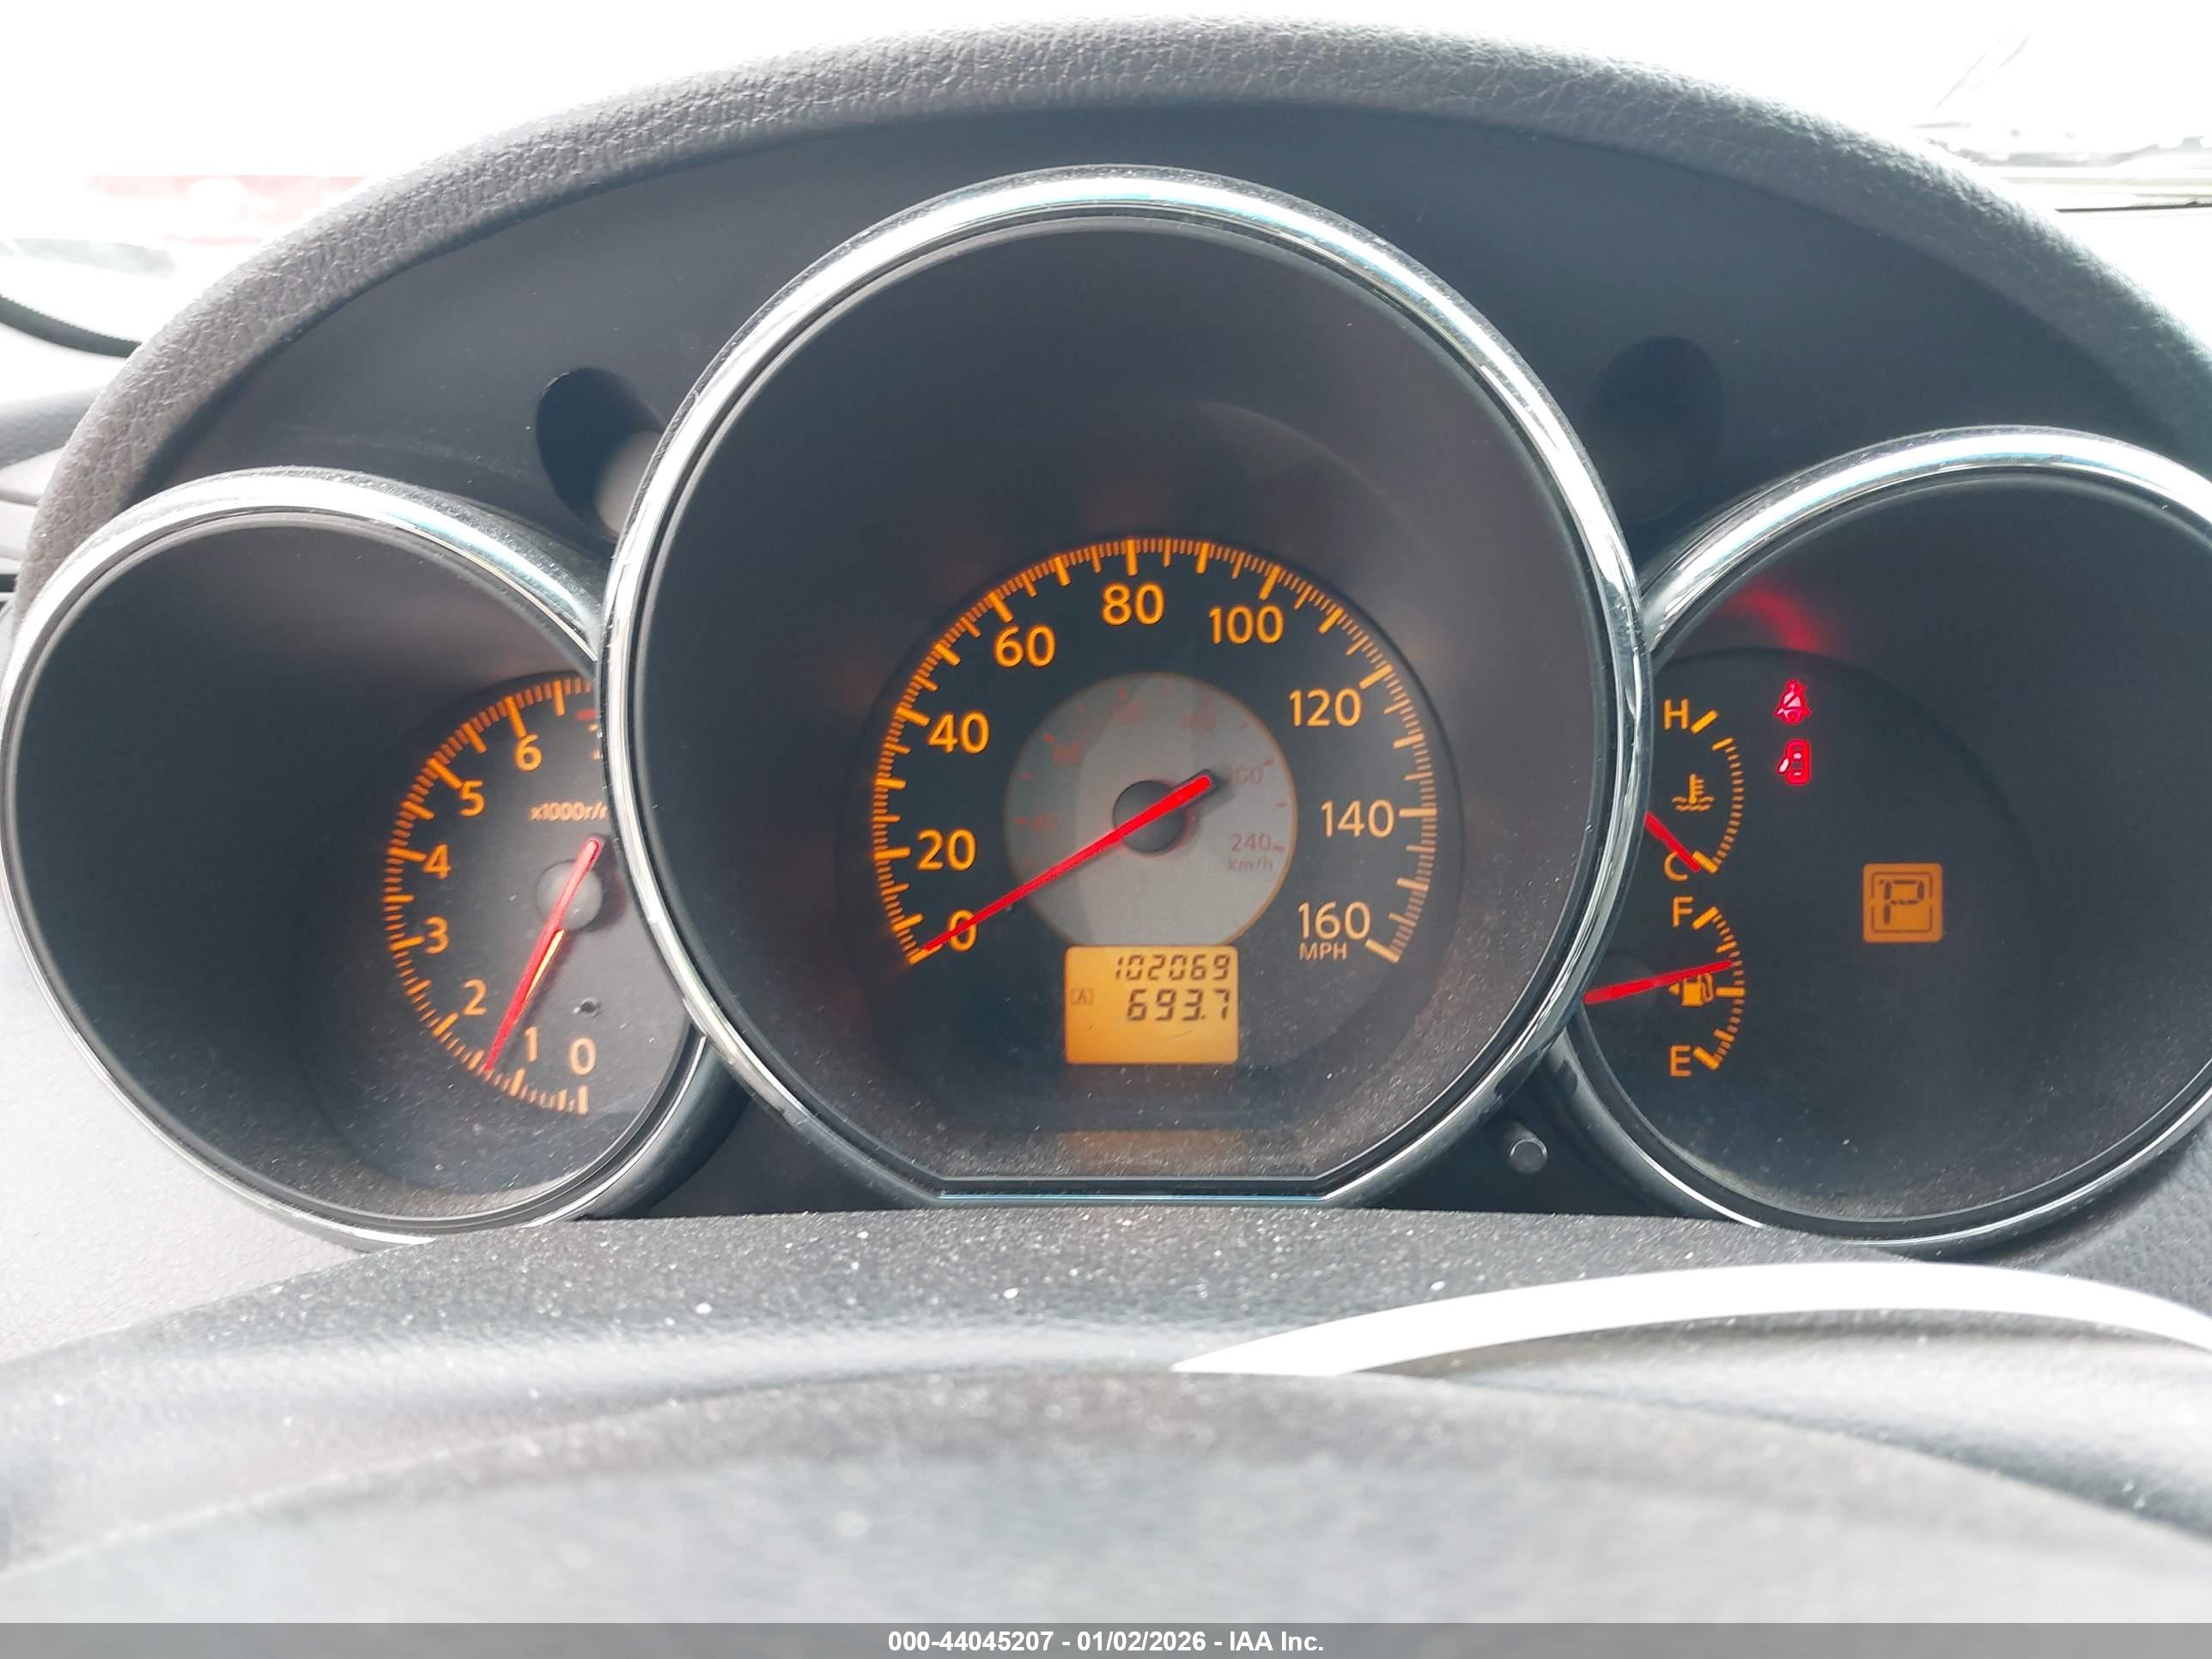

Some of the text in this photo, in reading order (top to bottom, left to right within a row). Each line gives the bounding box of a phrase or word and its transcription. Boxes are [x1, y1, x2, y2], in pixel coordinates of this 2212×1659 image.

[1102, 583, 1164, 625] 80
[1208, 605, 1285, 644] 100
[994, 625, 1056, 668] 60
[1289, 689, 1362, 727] 120
[1663, 699, 1689, 730] H
[515, 733, 543, 771] 6
[927, 712, 990, 754] 40
[459, 781, 485, 817] 5
[1321, 799, 1395, 837] 140
[423, 844, 452, 879] 4
[916, 829, 977, 871] 20
[1231, 833, 1273, 852] 240
[1228, 858, 1273, 873] km/h
[1663, 852, 1689, 882] C
[1297, 902, 1370, 940] 160
[1673, 896, 1693, 927] F
[1884, 879, 1925, 925] P
[423, 916, 450, 954] 3
[948, 909, 977, 952] 0
[1115, 954, 1231, 981] 102069
[1298, 942, 1347, 962] MPH
[462, 979, 488, 1017] 2
[1127, 988, 1231, 1022] 693.7
[525, 1026, 539, 1062] 1
[568, 1037, 597, 1076] 0
[1669, 1045, 1692, 1077] E
